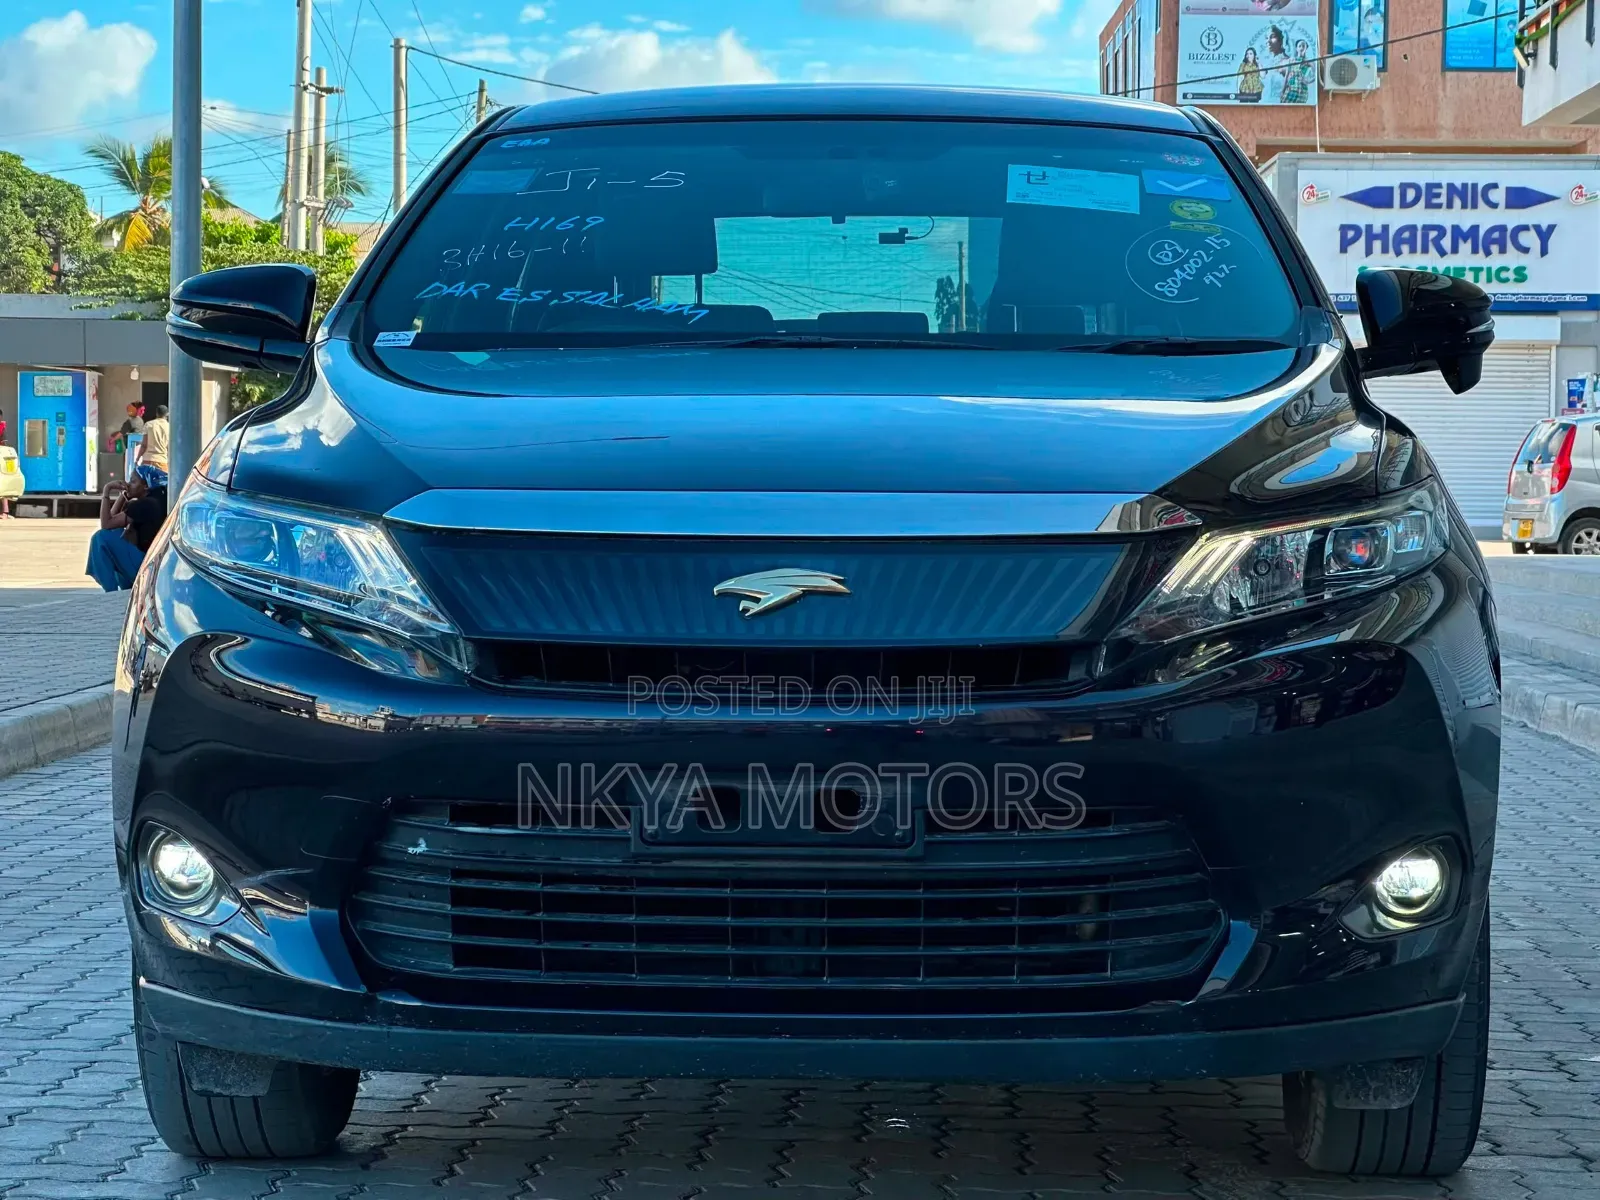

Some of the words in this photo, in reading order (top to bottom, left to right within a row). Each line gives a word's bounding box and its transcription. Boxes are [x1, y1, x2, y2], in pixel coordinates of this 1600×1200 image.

[1188, 53, 1237, 61] BIZZLEST
[1398, 182, 1500, 210] DENIC
[1338, 223, 1558, 258] PHARMACY
[414, 281, 491, 300] DAR
